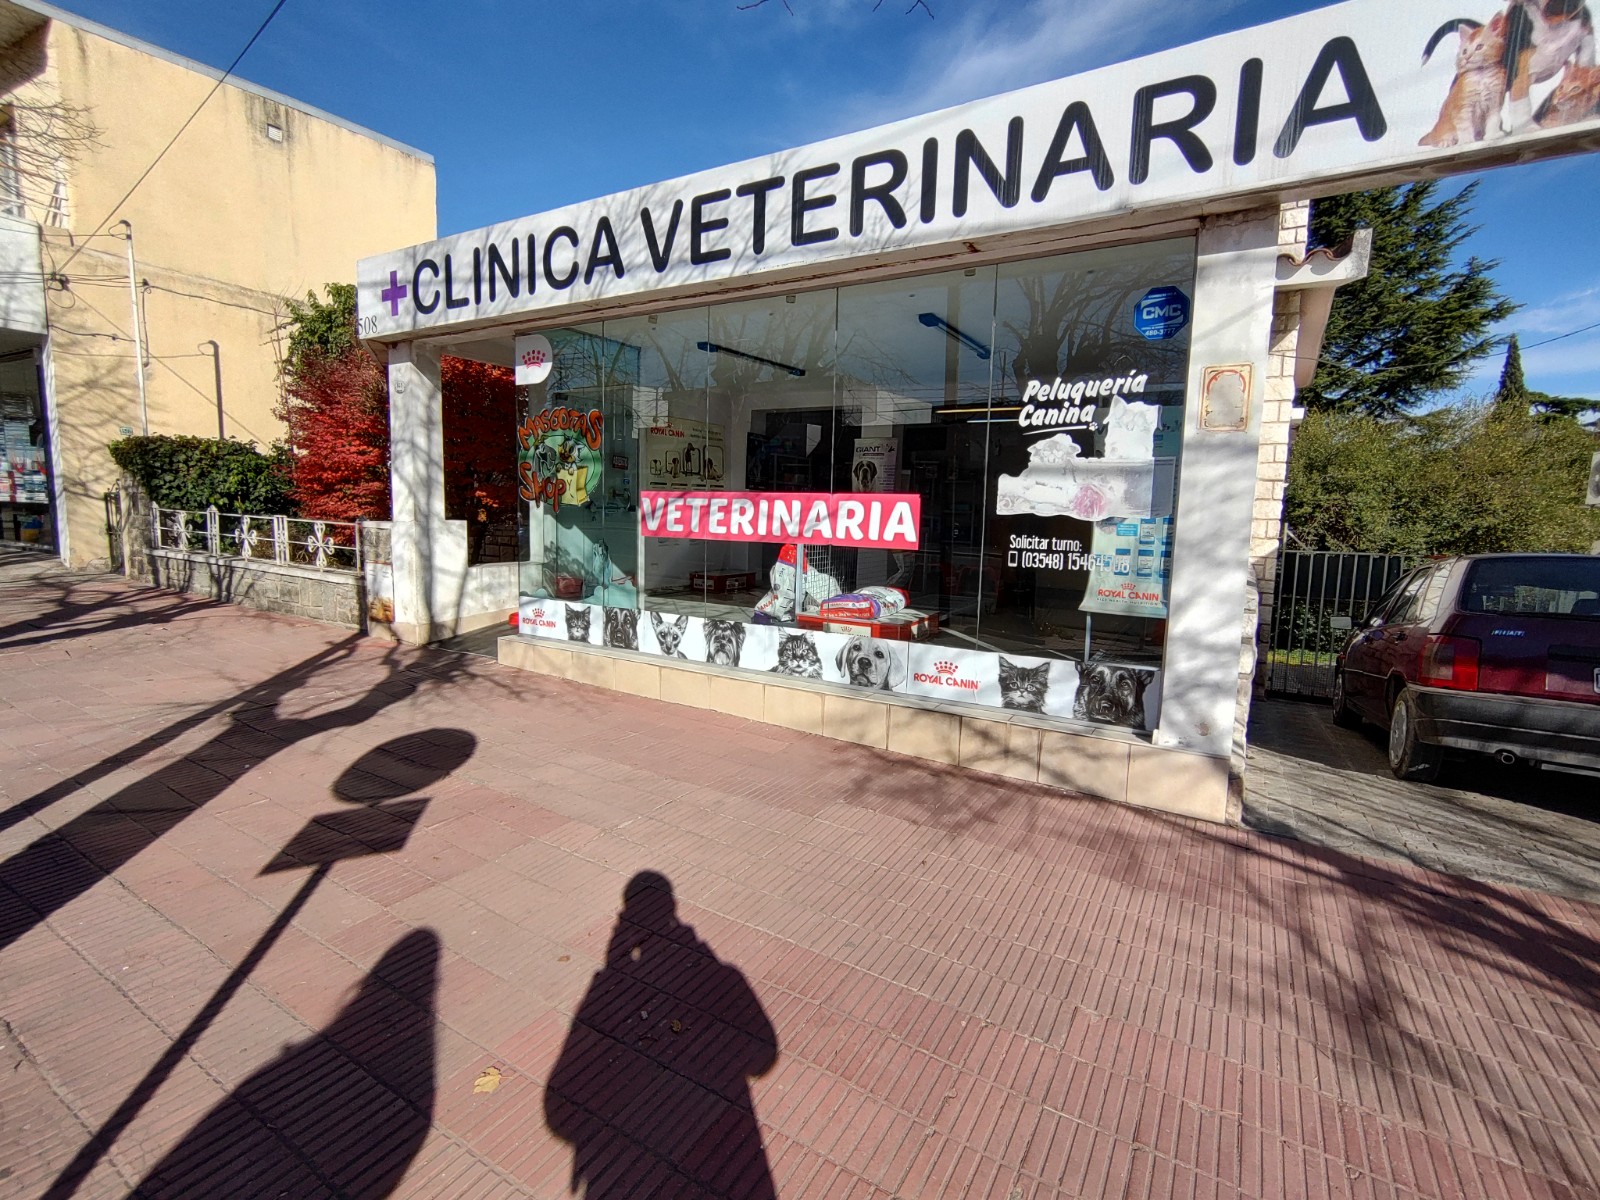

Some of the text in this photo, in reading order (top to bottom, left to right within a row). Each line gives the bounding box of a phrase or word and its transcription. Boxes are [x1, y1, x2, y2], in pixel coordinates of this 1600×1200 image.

[412, 35, 1388, 315] CLINICA VETERINARIA
[1022, 369, 1149, 406] Peluquería
[1018, 401, 1097, 428] Canina
[518, 406, 604, 450] MASCOTAS
[650, 427, 667, 436] ROYAL
[518, 461, 568, 513] SHOP
[641, 497, 917, 543] VETERINARIA
[1010, 534, 1083, 552] Solicitar turno:
[1021, 550, 1130, 574] (03548) 15464508
[1097, 588, 1160, 602] ROYAL CANIN
[522, 617, 557, 628] ROYAL CANIN
[913, 672, 979, 690] ROYAL CANIN
